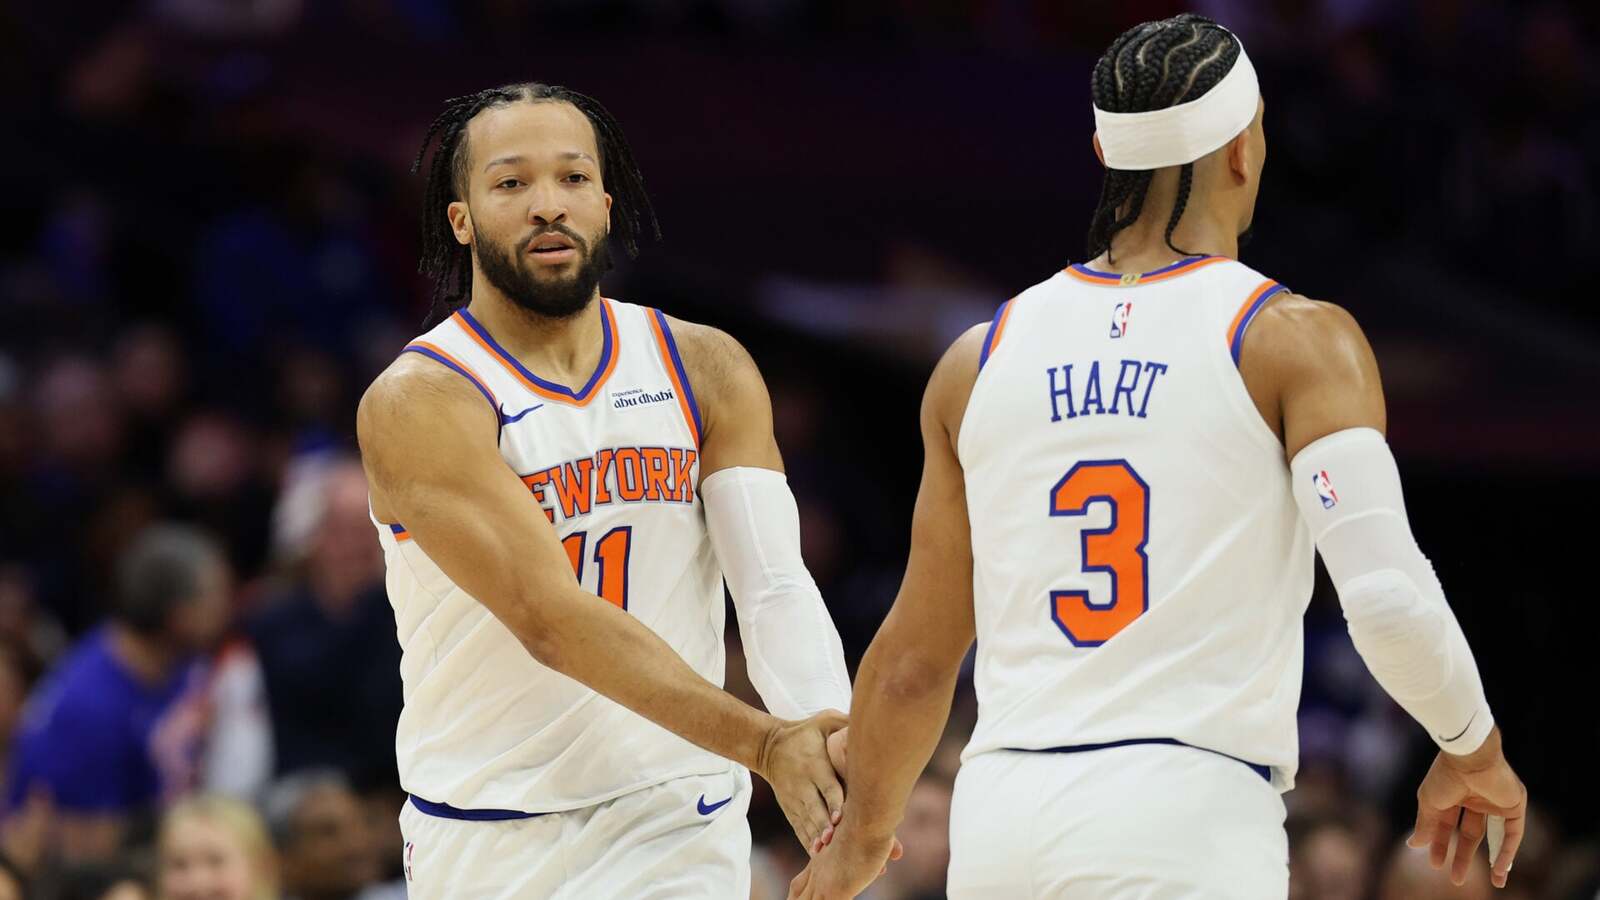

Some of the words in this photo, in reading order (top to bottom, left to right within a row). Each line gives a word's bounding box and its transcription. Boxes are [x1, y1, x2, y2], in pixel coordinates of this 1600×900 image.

[614, 397, 637, 409] abu
[638, 388, 674, 404] dhabi
[1046, 359, 1168, 422] HART
[520, 457, 594, 524] EW
[594, 446, 697, 505] YORK
[1049, 458, 1151, 648] 3
